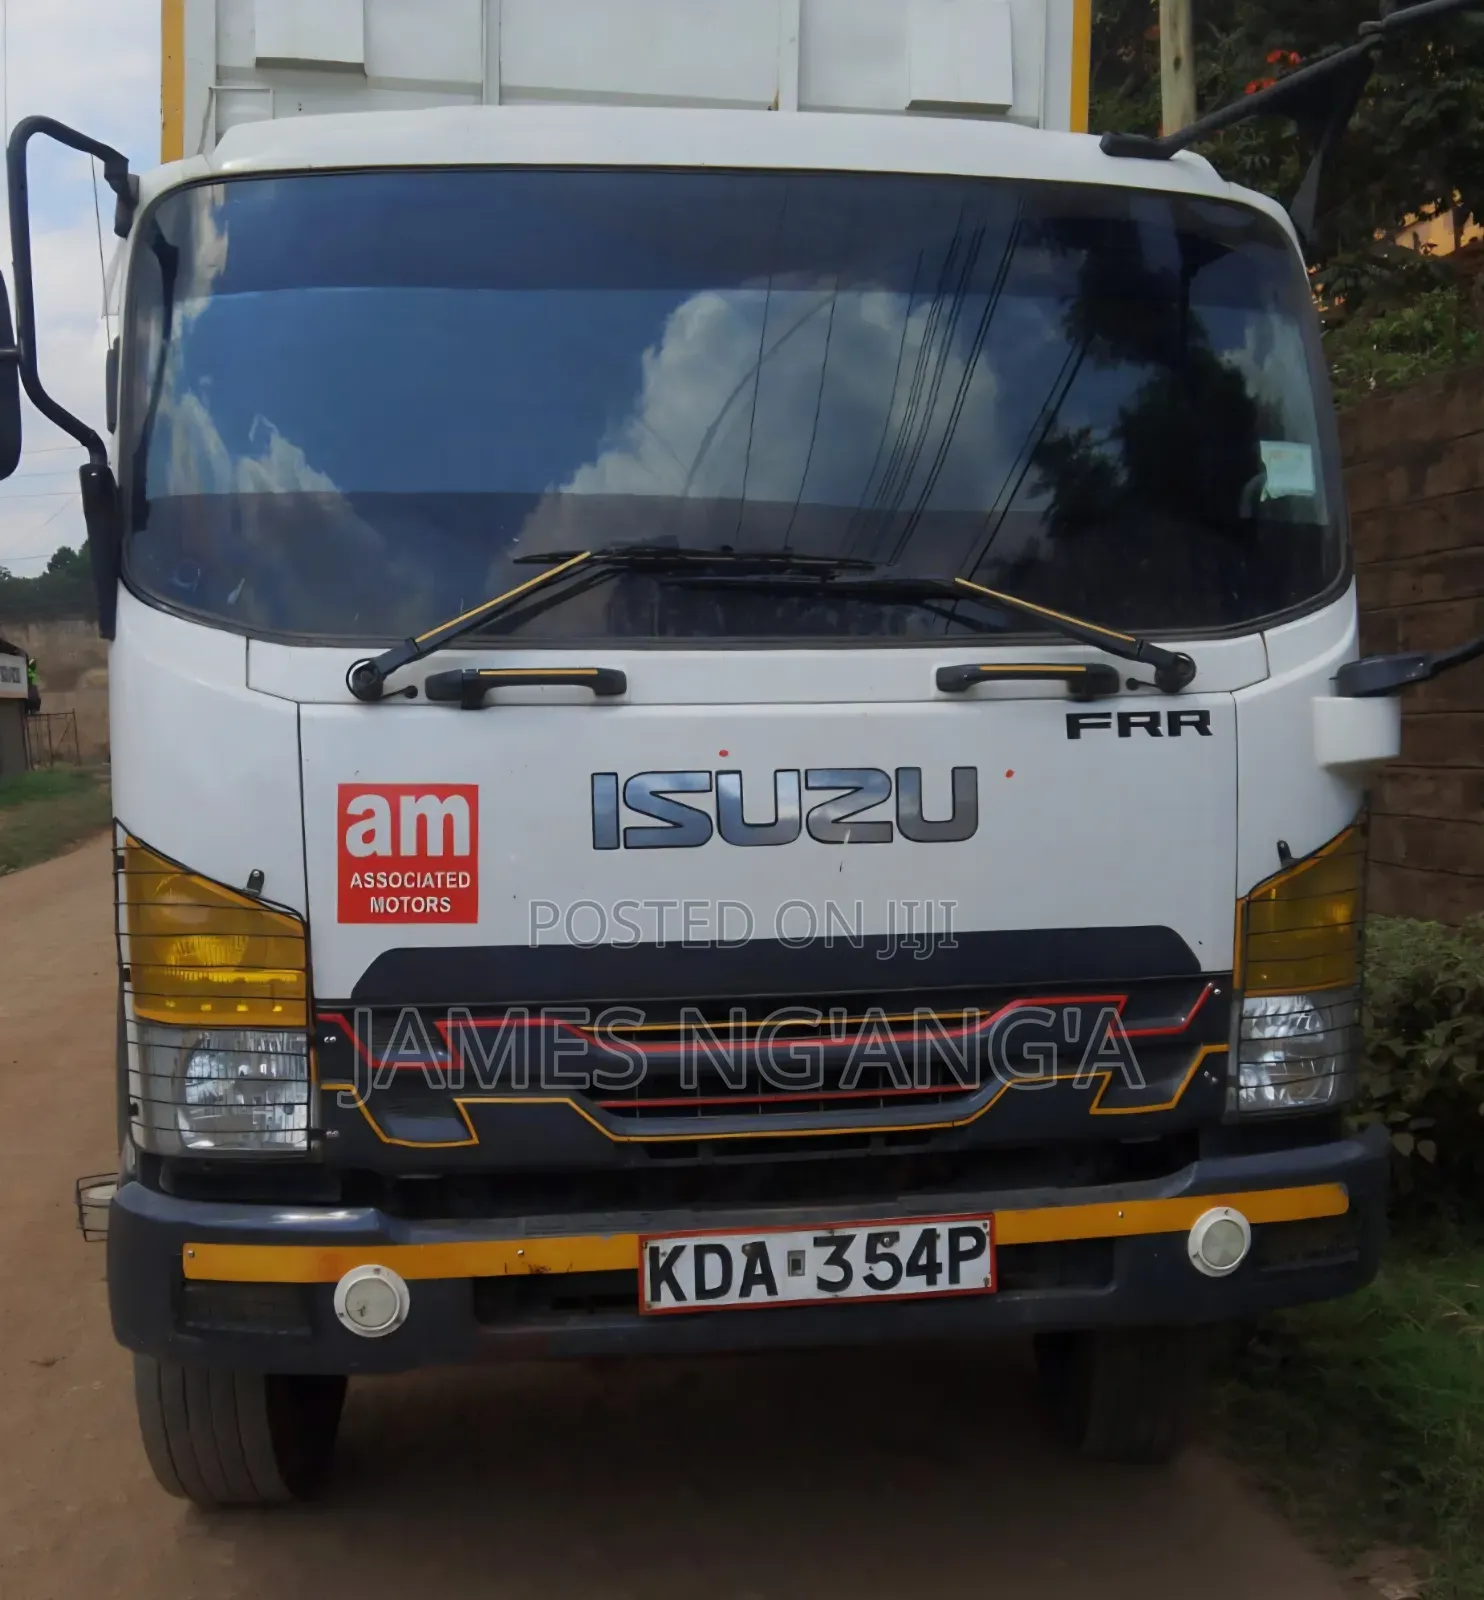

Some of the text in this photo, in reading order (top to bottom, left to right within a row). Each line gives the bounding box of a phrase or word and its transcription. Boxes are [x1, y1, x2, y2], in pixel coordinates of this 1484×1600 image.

[1066, 710, 1213, 739] FRR
[345, 794, 470, 858] am
[591, 766, 979, 850] ISUZU
[350, 871, 471, 889] ASSOCIATED
[370, 896, 451, 913] MOTORS
[649, 1225, 988, 1304] KDA 354P
